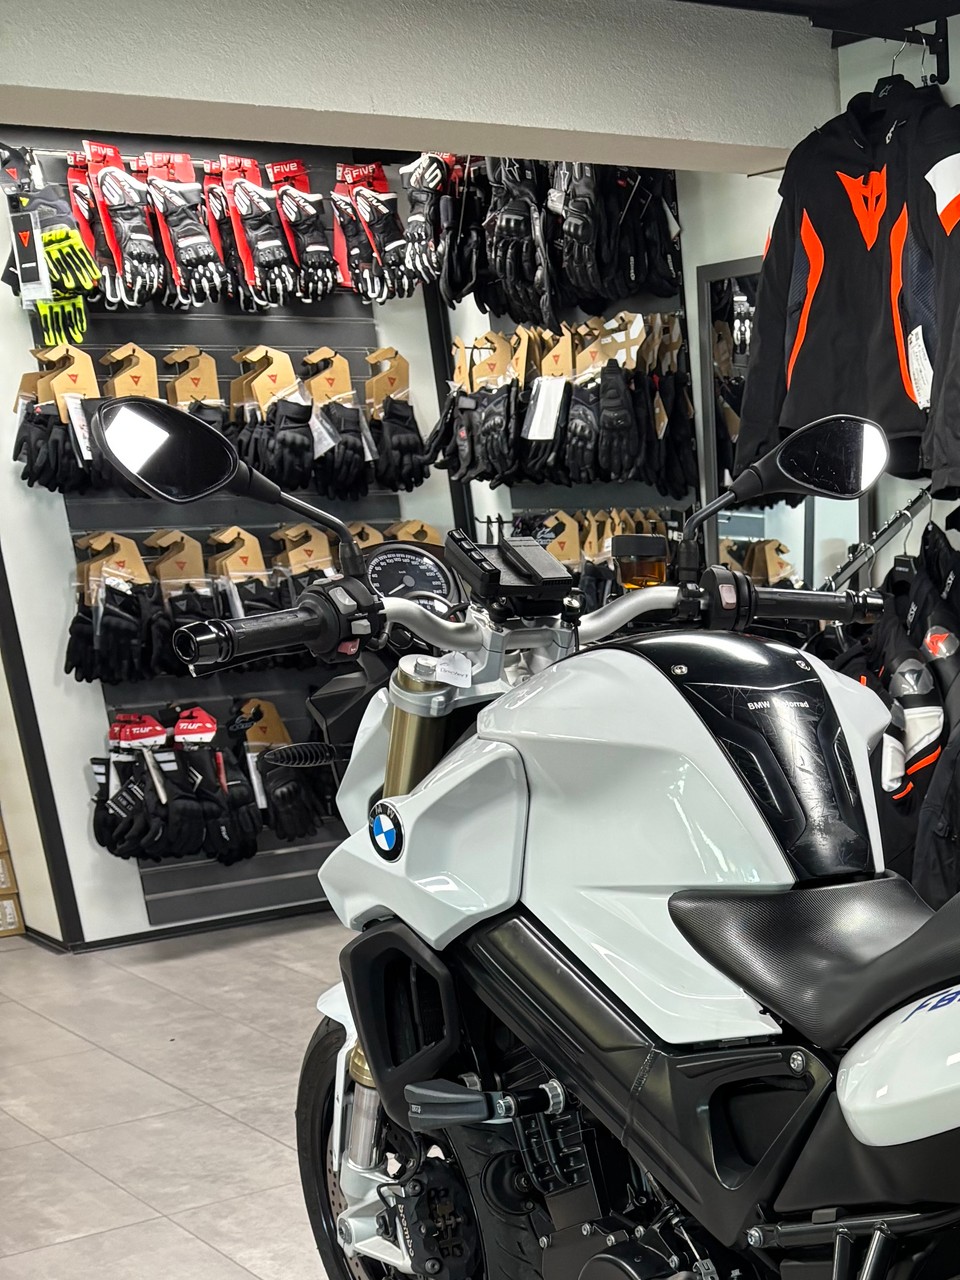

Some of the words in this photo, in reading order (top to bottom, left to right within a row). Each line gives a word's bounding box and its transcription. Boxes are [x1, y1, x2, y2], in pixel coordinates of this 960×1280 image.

[90, 145, 114, 156] FIVE
[273, 162, 298, 174] FIVE
[352, 164, 376, 178] FIVE
[747, 701, 770, 710] BMW
[398, 1204, 415, 1257] brembo
